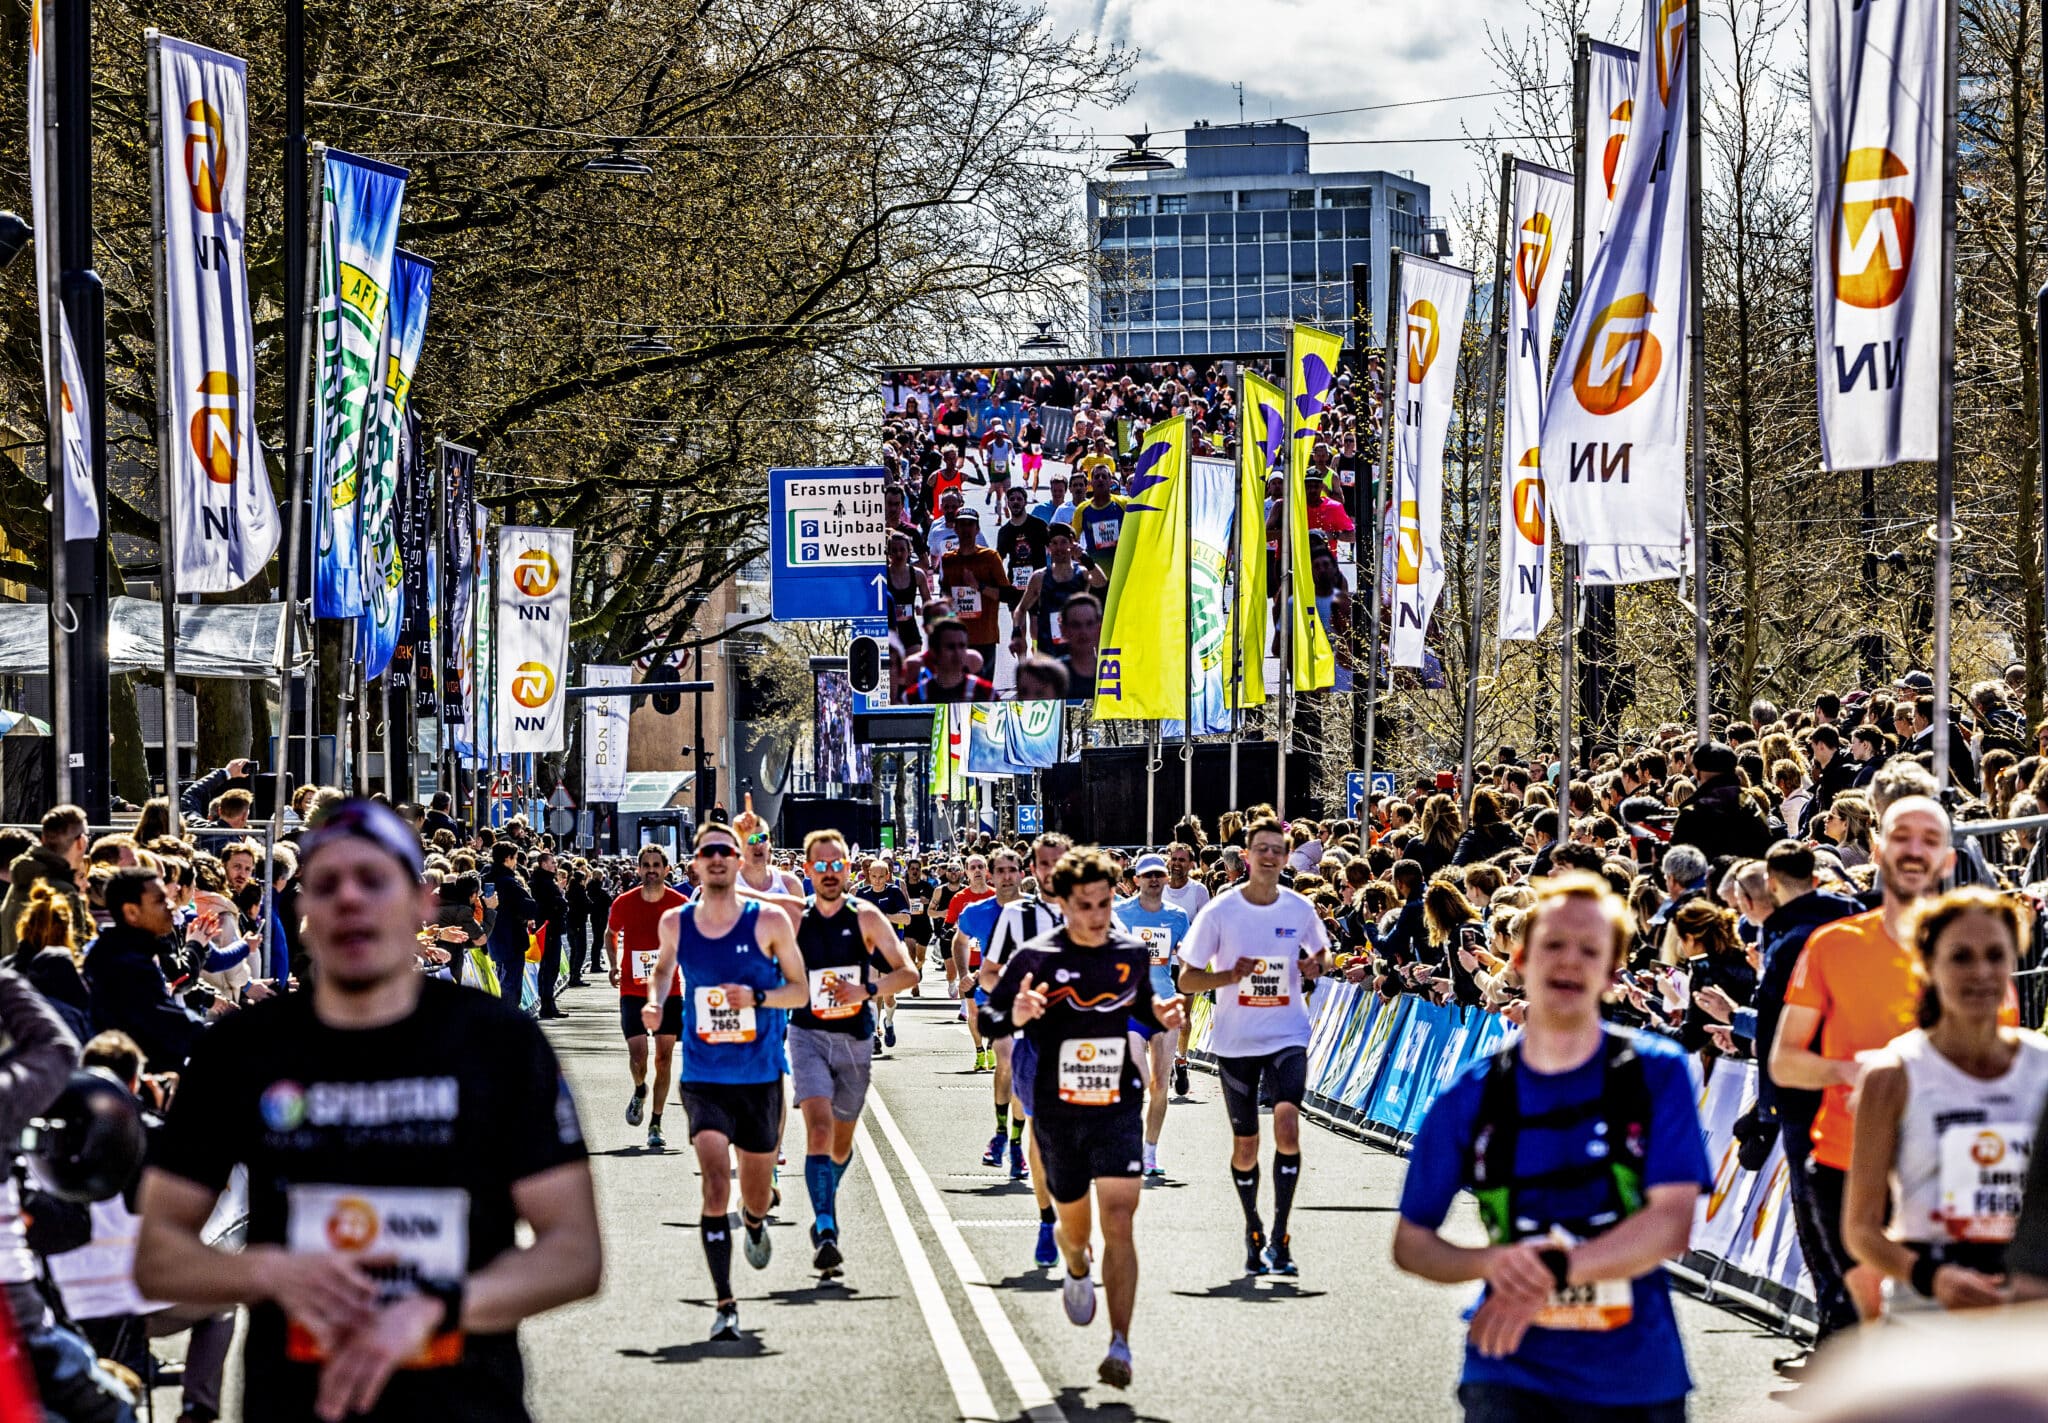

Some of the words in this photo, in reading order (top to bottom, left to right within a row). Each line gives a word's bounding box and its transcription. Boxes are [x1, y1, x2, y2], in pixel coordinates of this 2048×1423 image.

[853, 500, 883, 517] Lijn
[824, 520, 884, 538] Lijnbaa
[518, 604, 551, 622] NN
[515, 716, 546, 732] NN
[596, 727, 608, 765] BON
[1269, 963, 1284, 971] NN
[1251, 975, 1280, 984] Olivier
